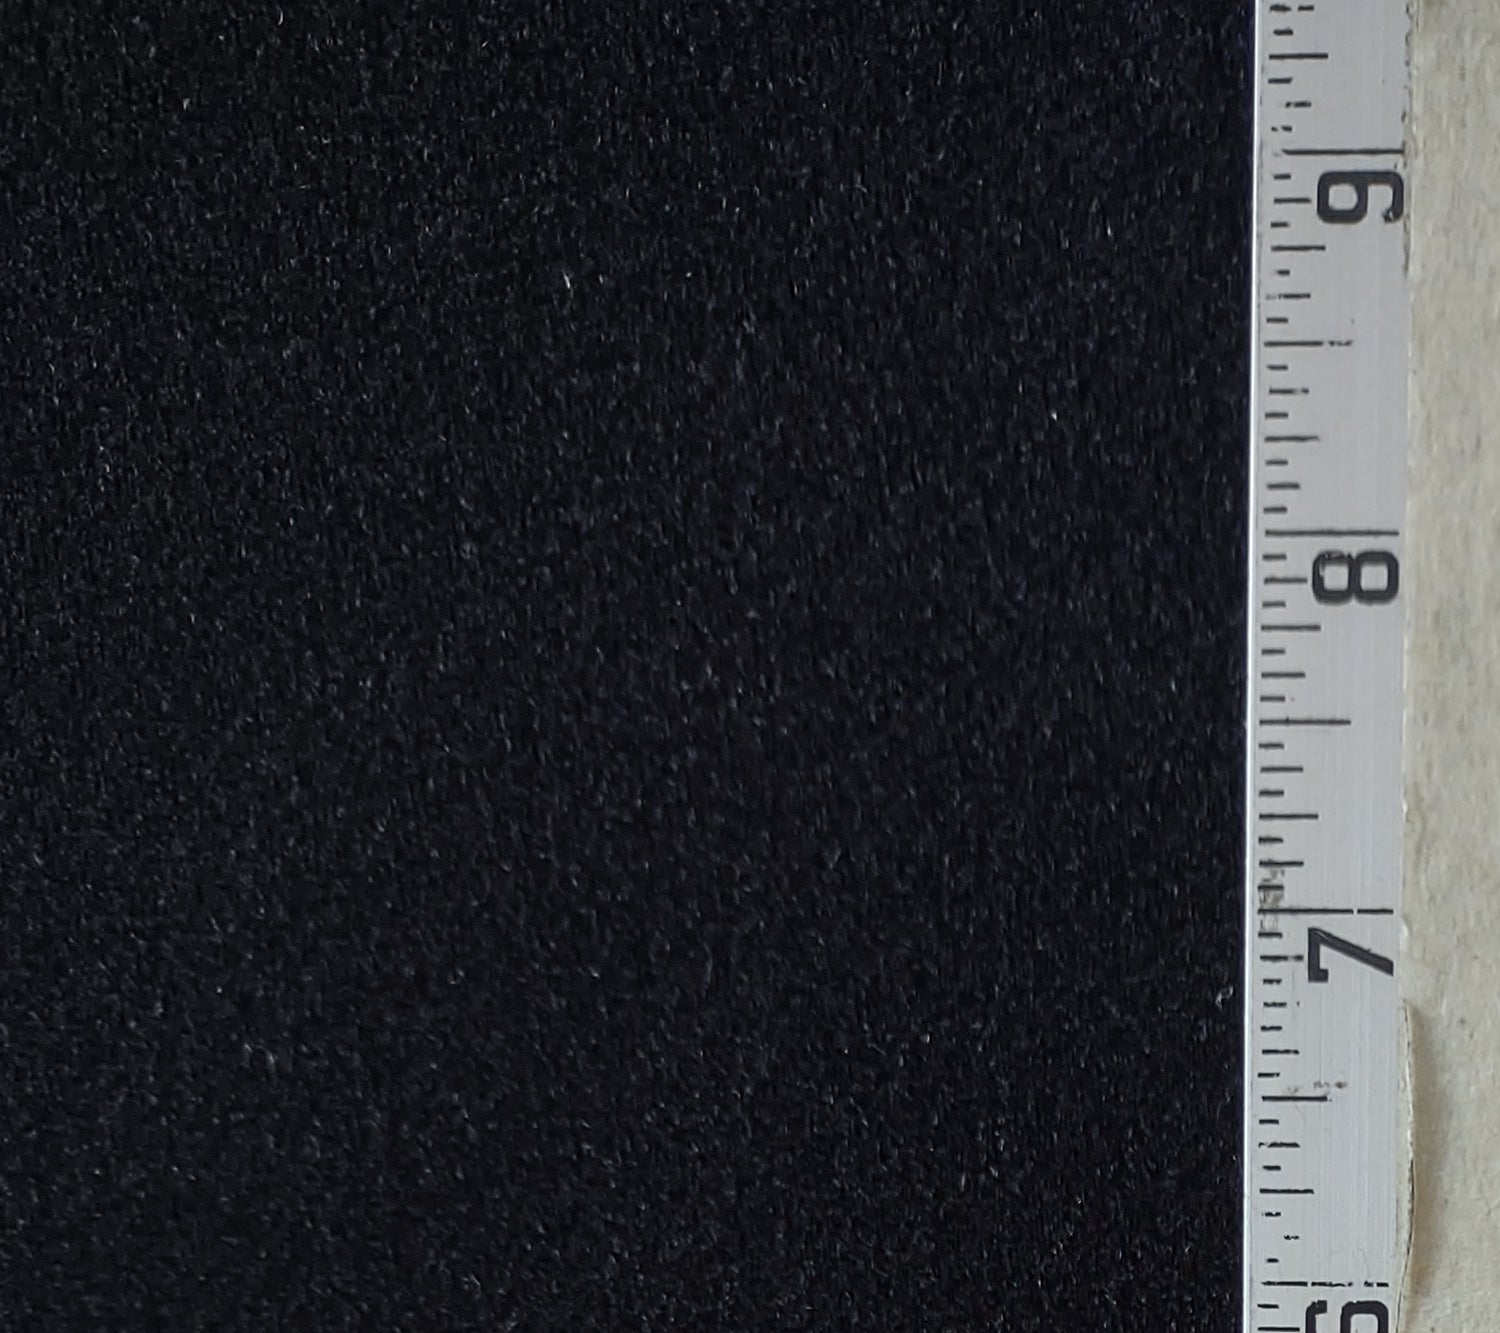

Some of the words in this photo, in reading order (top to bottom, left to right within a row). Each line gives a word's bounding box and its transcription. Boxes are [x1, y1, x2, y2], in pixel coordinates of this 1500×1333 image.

[1317, 171, 1403, 223] 9
[1312, 550, 1398, 604] 8
[1307, 926, 1394, 982] 7
